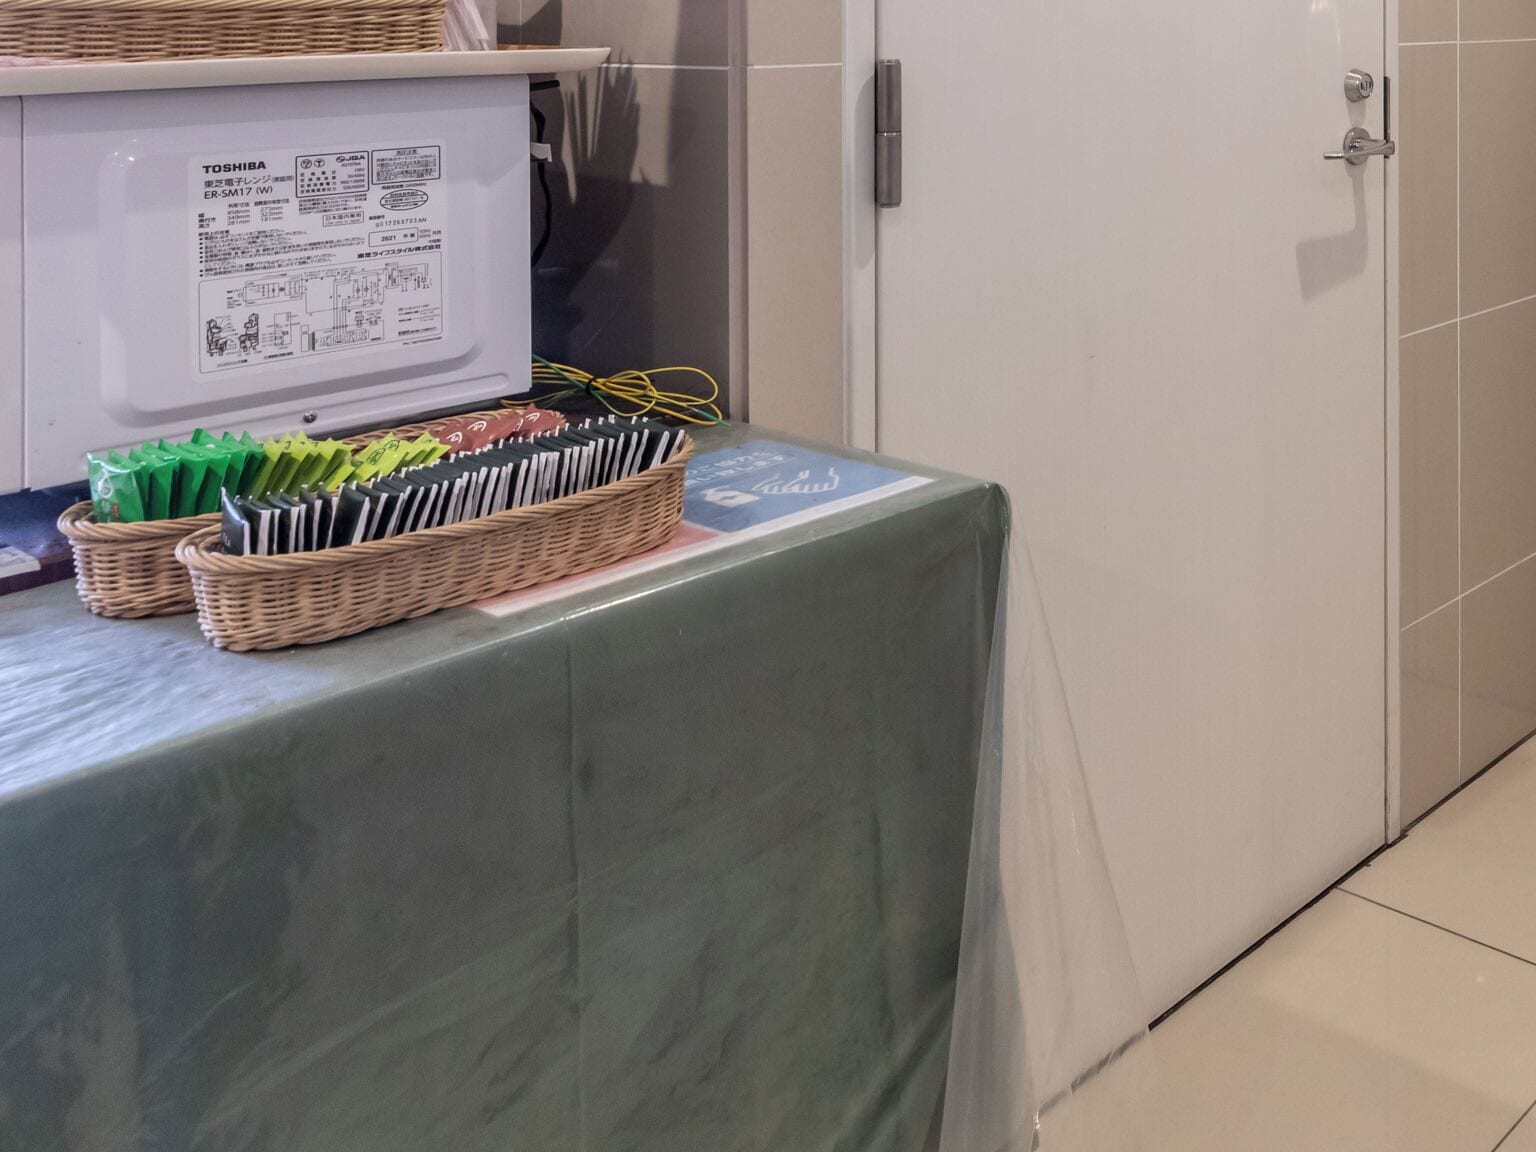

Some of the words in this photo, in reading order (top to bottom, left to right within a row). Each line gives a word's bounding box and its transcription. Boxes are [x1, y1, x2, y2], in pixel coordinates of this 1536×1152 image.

[202, 161, 266, 174] TOSHIBA
[204, 187, 252, 200] ER-SM17
[256, 185, 273, 196] (W)
